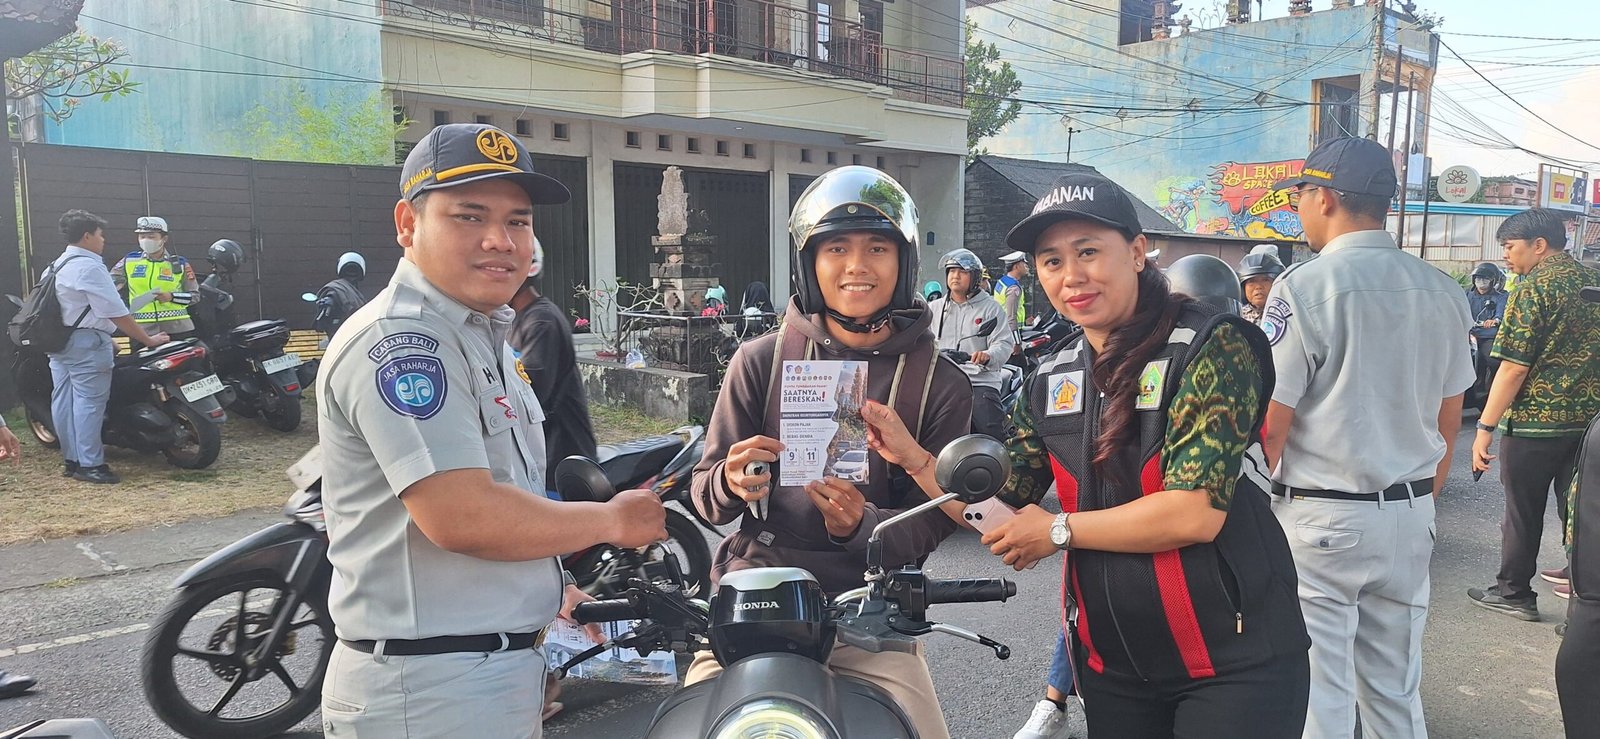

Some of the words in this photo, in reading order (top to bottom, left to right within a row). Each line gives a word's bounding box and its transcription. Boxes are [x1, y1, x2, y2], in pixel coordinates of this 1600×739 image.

[1243, 180, 1273, 190] SPACE
[1251, 189, 1284, 213] COFFEE
[374, 336, 409, 357] CABANG
[411, 336, 432, 349] BALI
[383, 365, 401, 382] JASA
[400, 361, 436, 373] RAHARJA
[789, 451, 795, 461] 9
[807, 452, 815, 461] 11
[733, 601, 780, 611] HONDA
